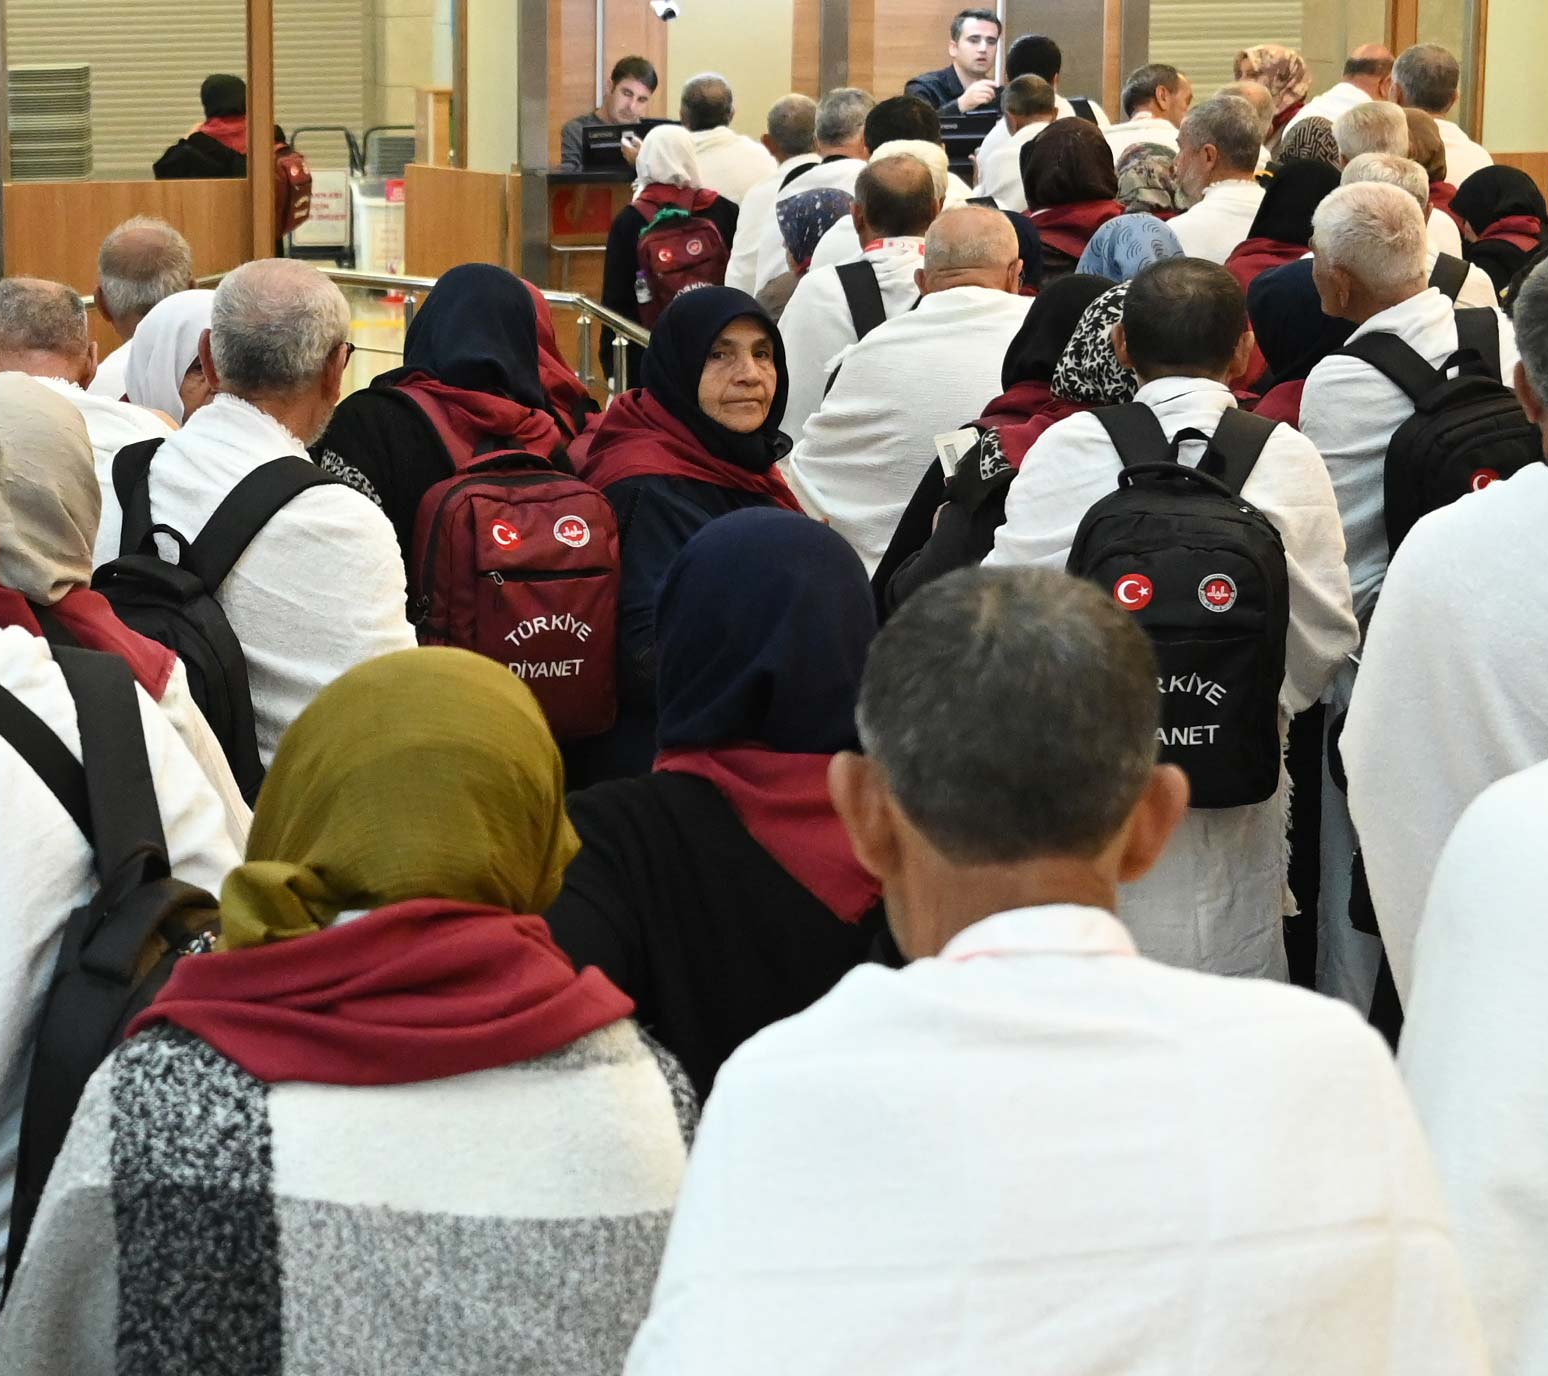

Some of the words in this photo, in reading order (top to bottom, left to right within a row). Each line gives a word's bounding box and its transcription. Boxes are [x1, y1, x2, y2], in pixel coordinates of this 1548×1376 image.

[505, 613, 592, 648] TÜRKİYE
[508, 659, 584, 679] DİYANET
[1155, 672, 1227, 706] RKİYE
[1154, 725, 1220, 746] ANET
